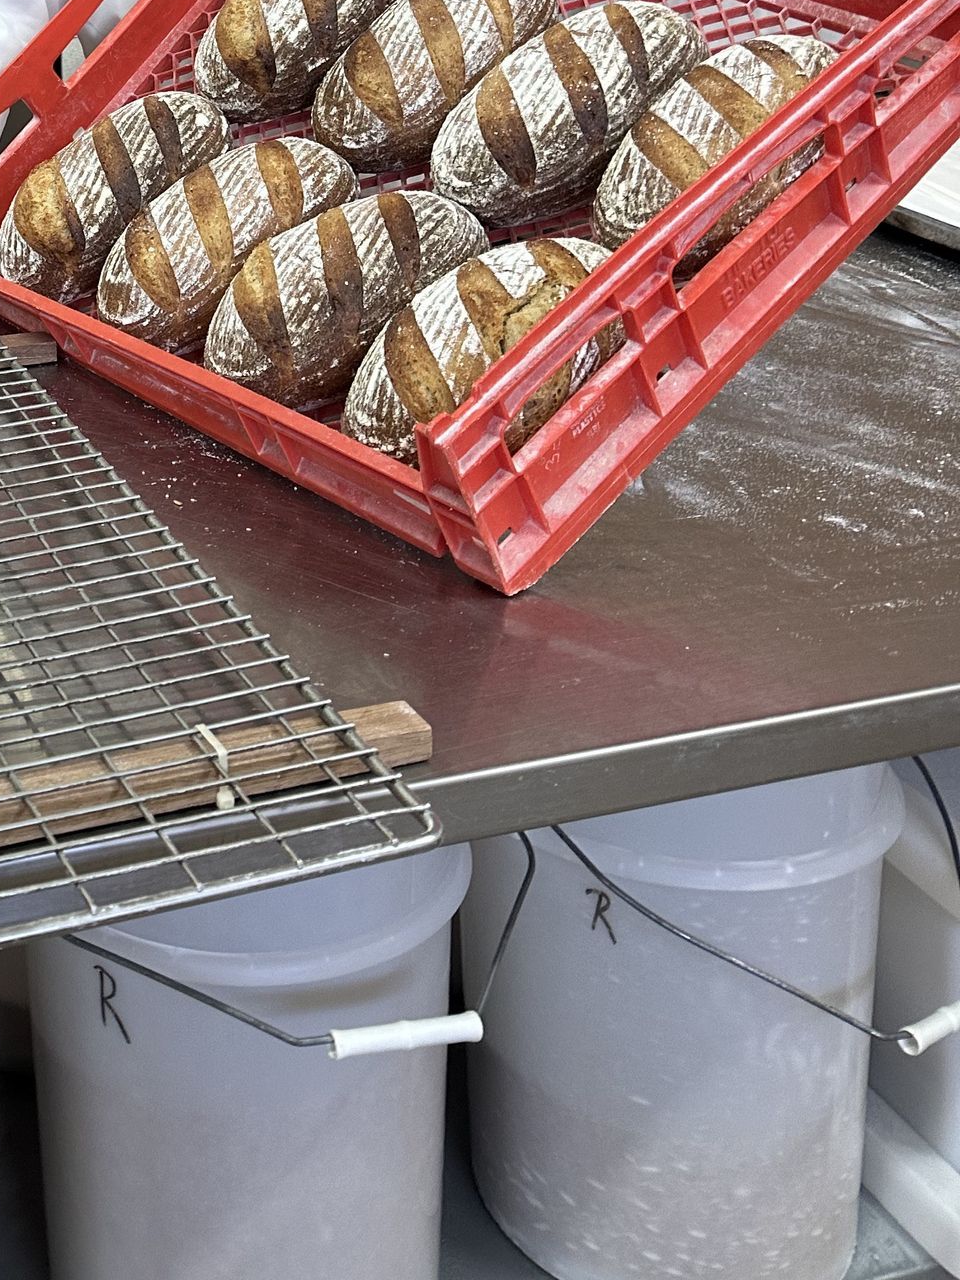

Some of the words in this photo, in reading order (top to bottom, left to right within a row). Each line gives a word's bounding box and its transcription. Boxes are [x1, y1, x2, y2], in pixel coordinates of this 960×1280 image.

[720, 226, 796, 311] BAKERIES
[585, 887, 617, 946] R
[93, 965, 132, 1045] R
